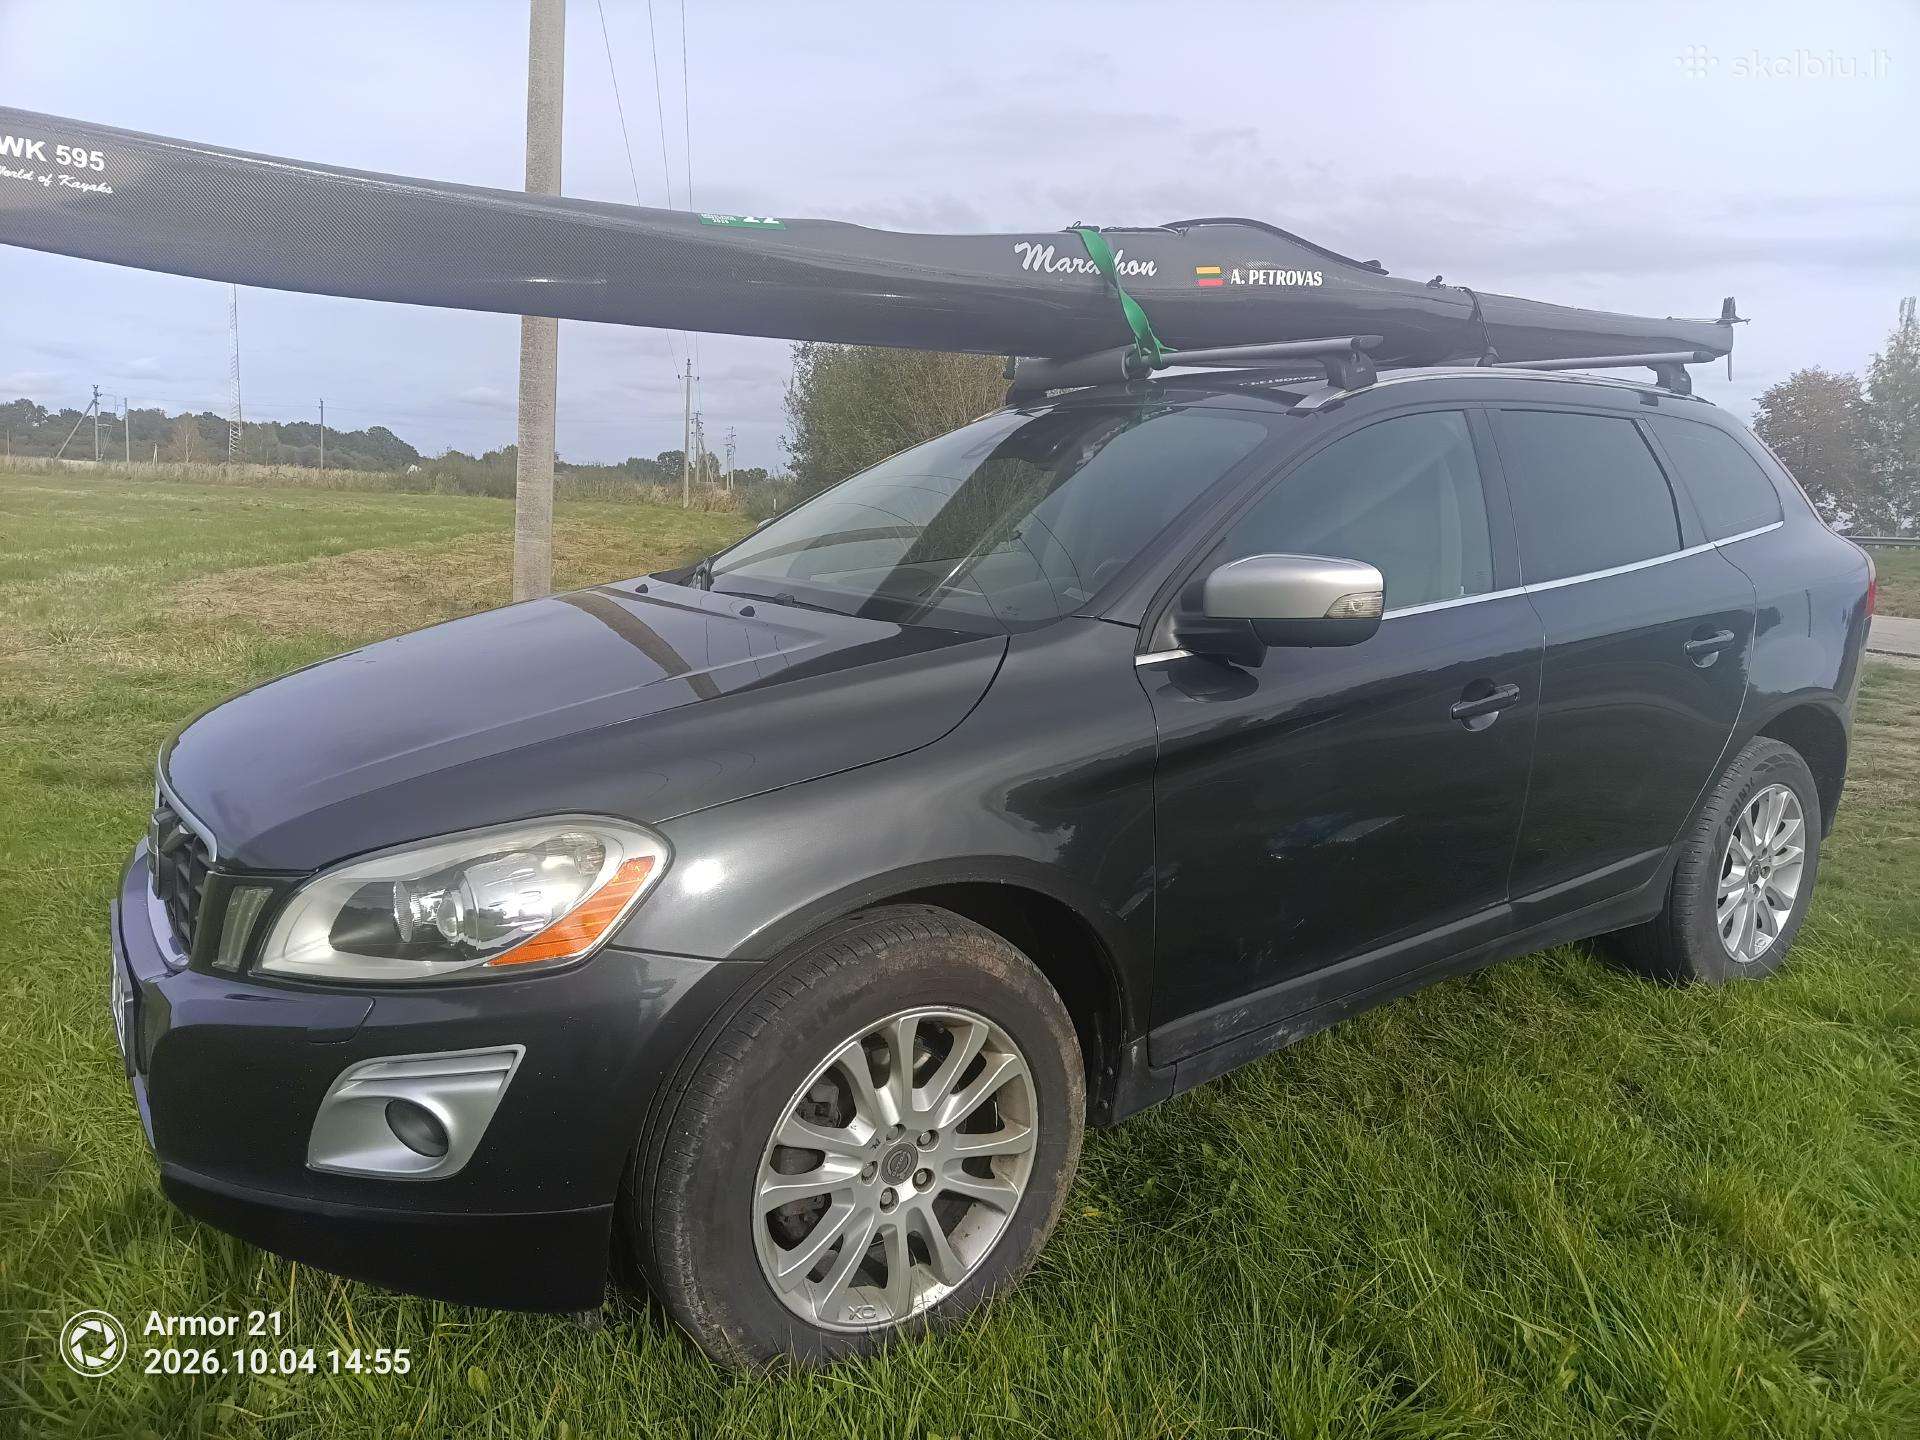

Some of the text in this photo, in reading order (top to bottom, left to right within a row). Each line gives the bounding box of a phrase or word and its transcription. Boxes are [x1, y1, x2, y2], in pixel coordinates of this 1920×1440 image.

[56, 144, 105, 171] 595
[38, 173, 53, 187] of
[1014, 241, 1158, 277] Marahon
[1230, 268, 1323, 287] A. PETROVAS
[848, 1304, 877, 1321] XC
